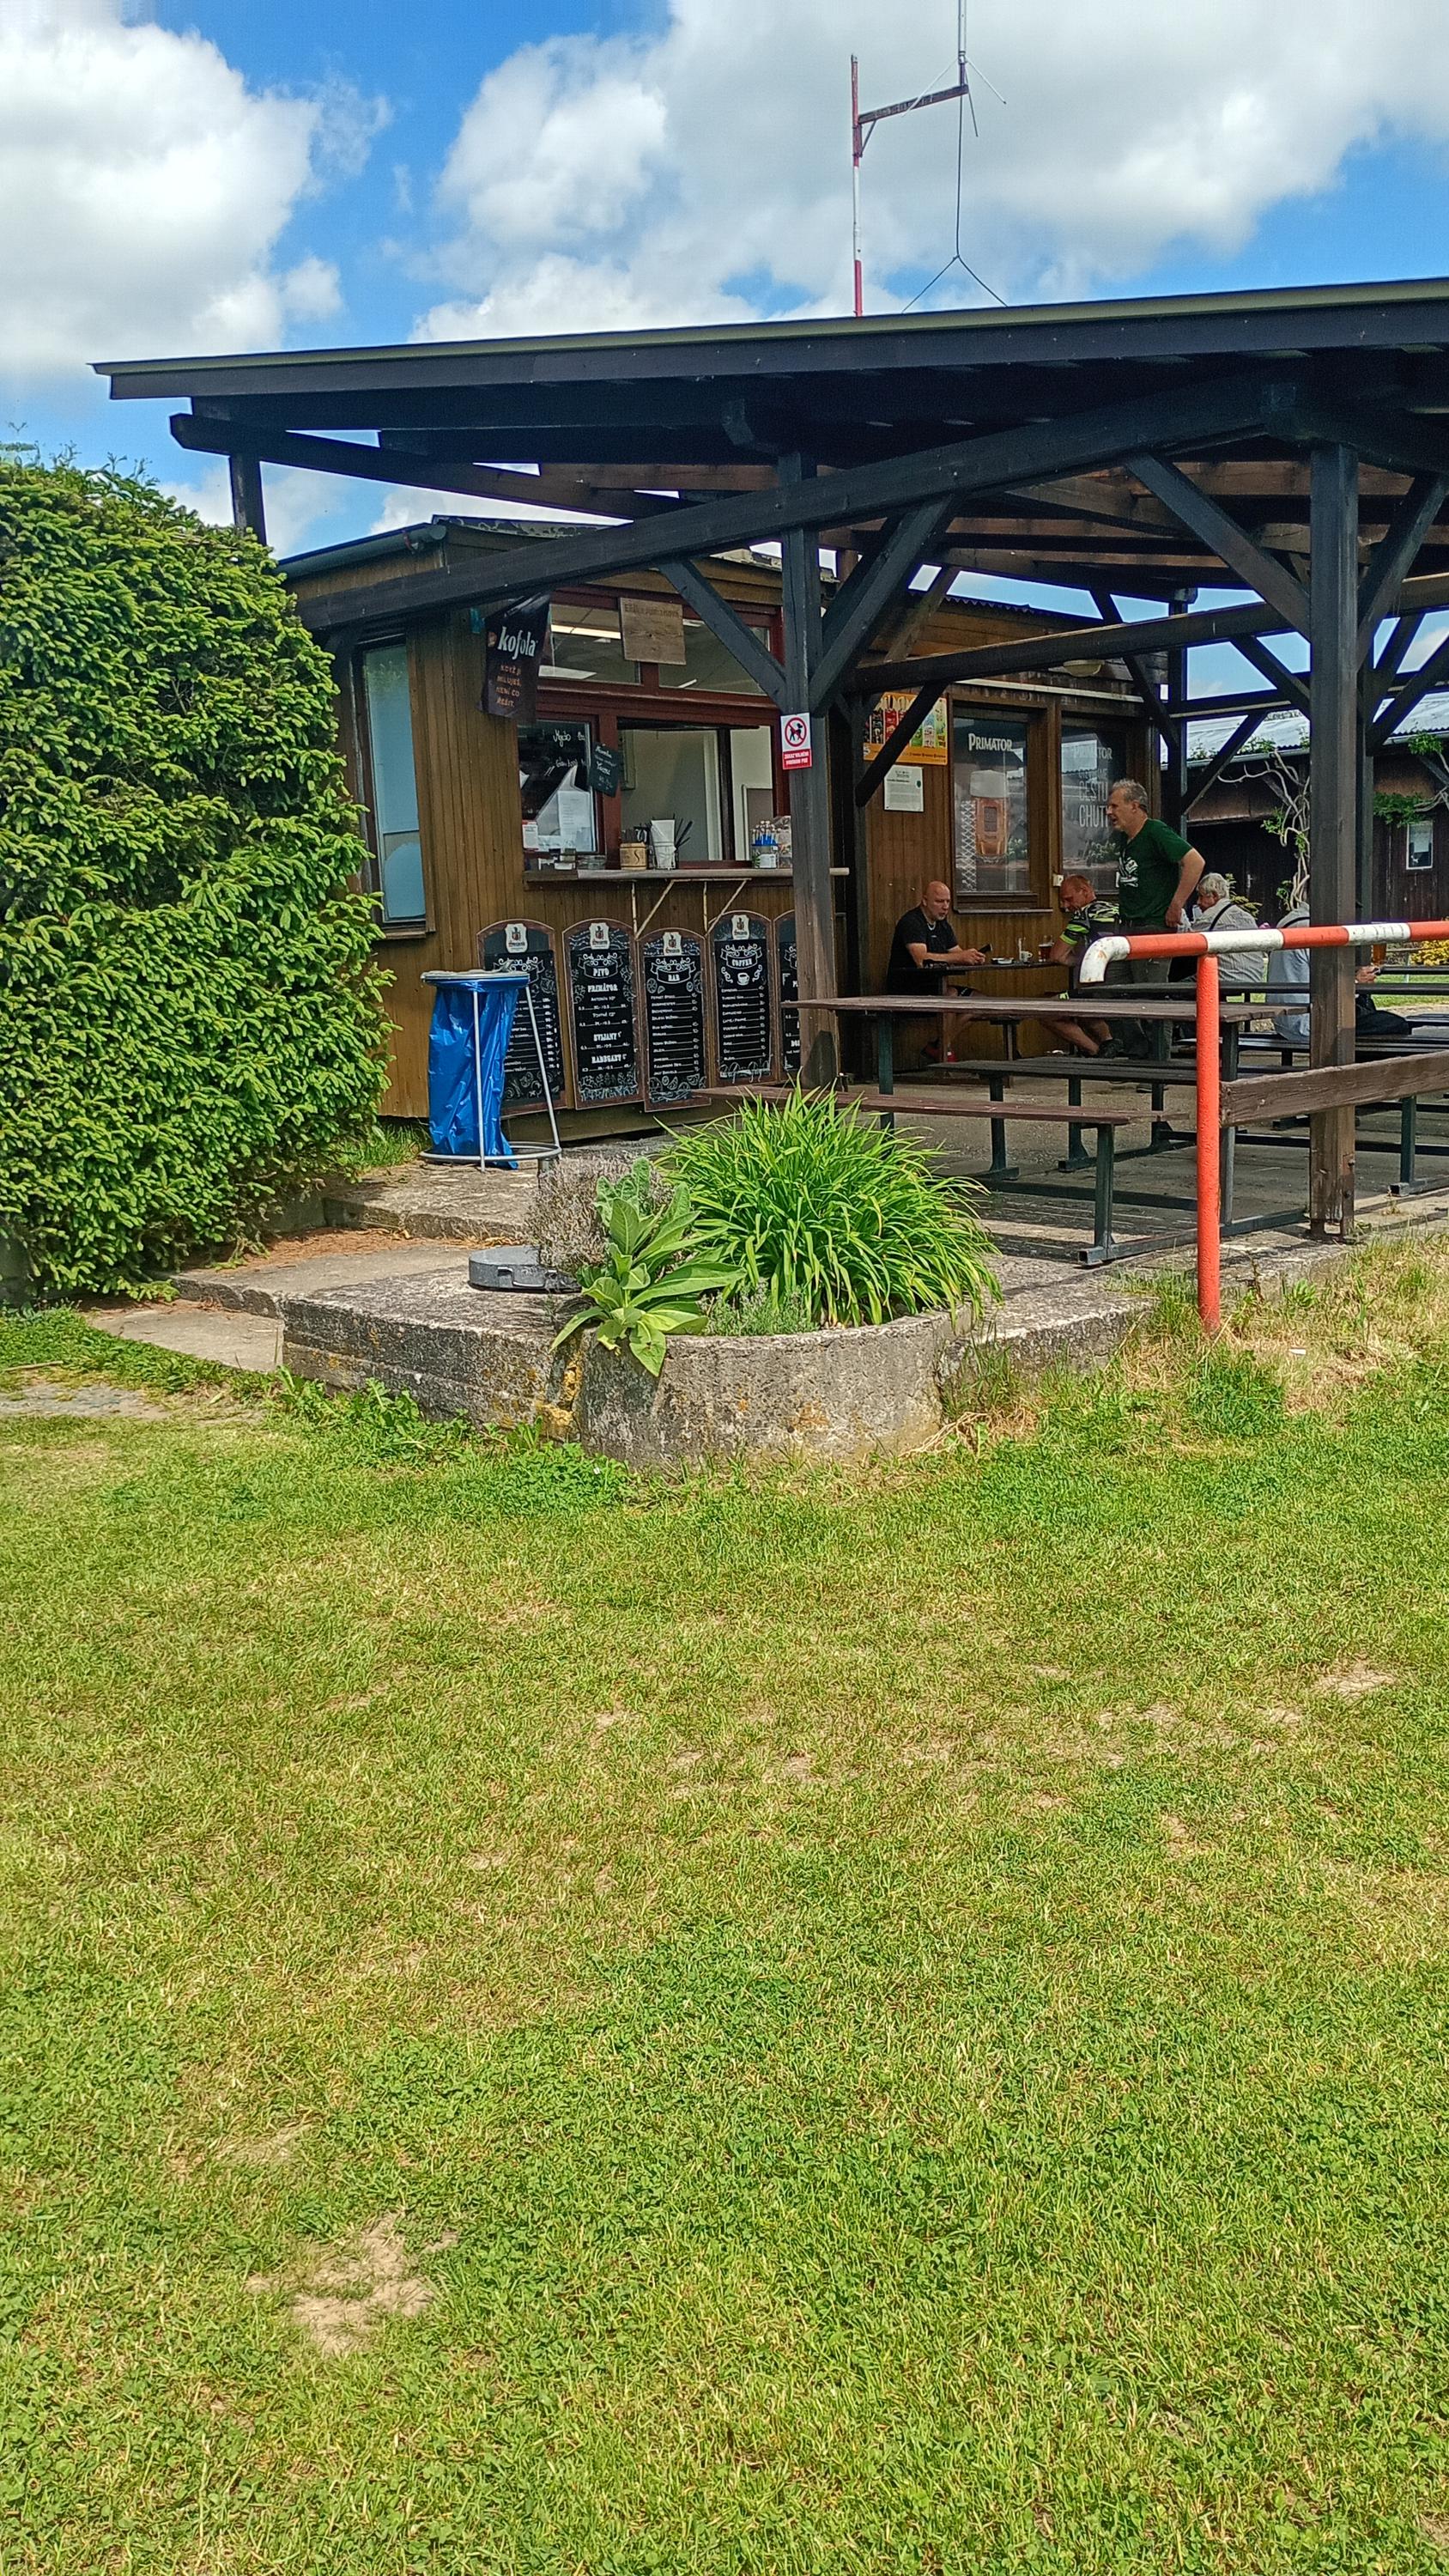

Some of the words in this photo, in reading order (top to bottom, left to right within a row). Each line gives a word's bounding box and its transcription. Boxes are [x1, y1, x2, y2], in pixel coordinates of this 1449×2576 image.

[498, 626, 536, 659] kofola
[968, 733, 1013, 751] PRIMATOR
[593, 968, 609, 977] PIVO
